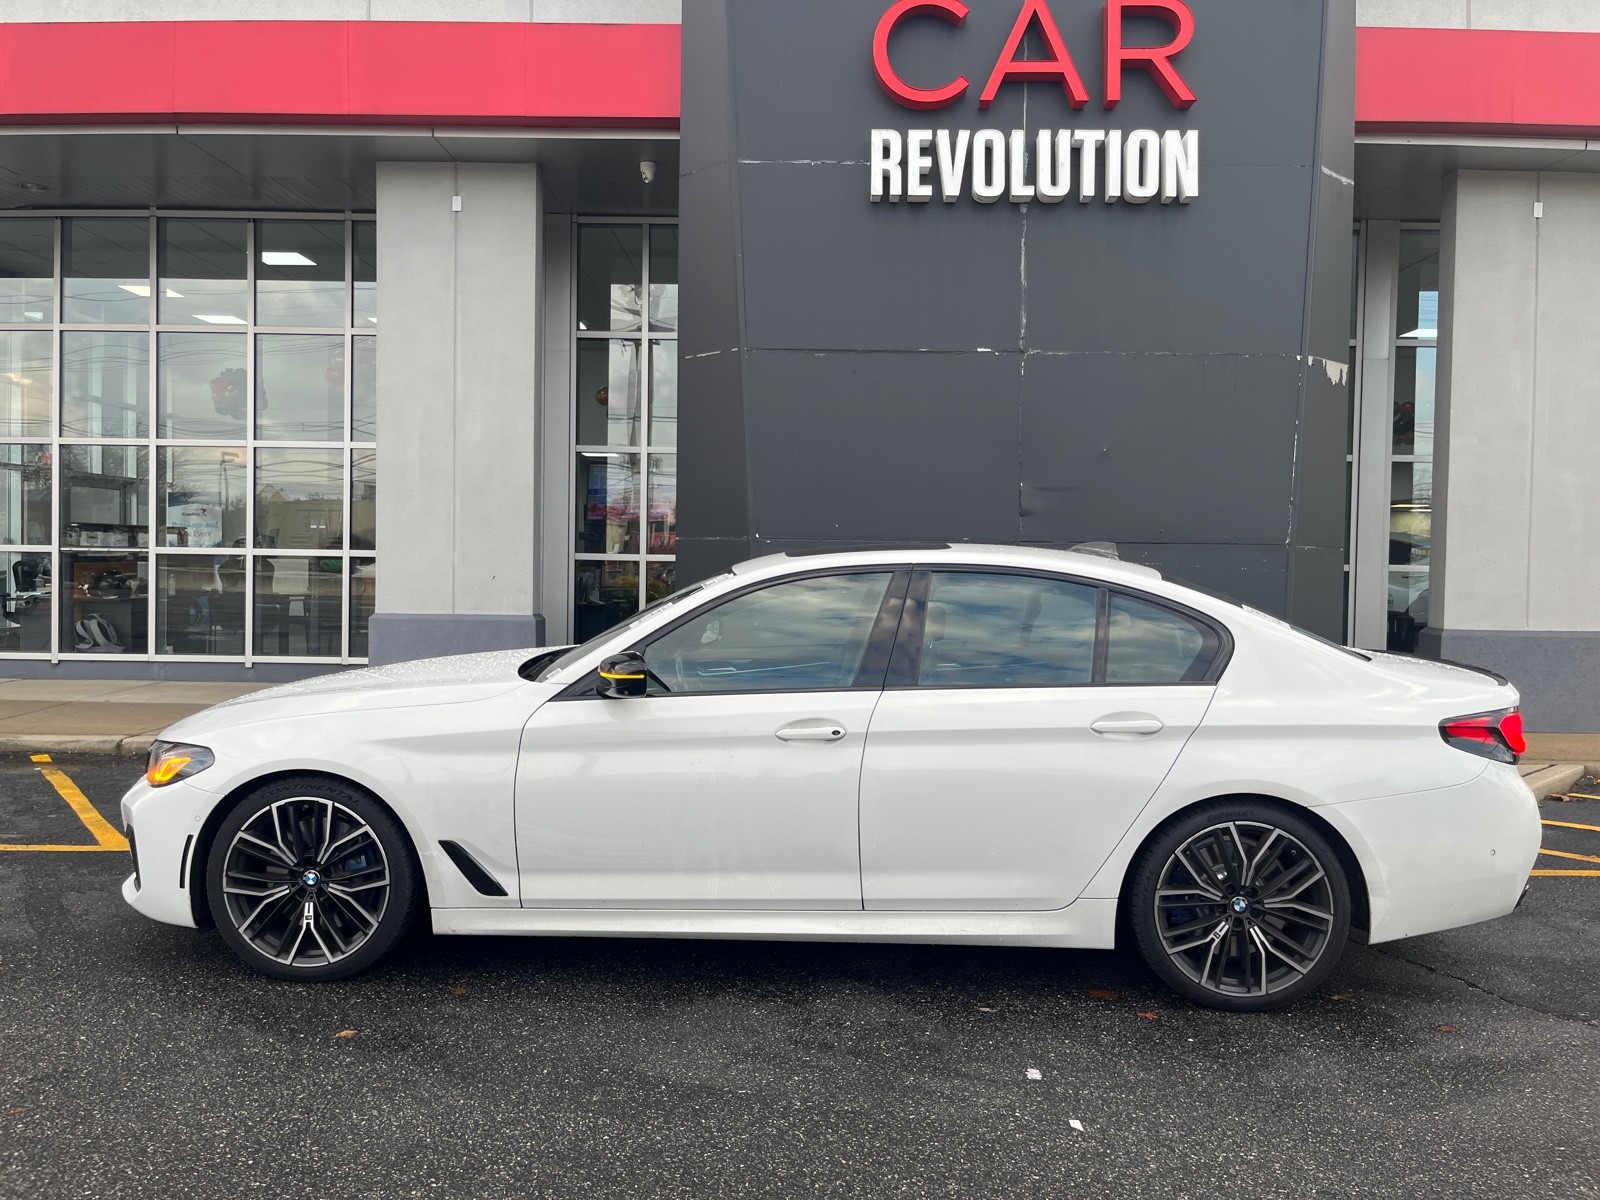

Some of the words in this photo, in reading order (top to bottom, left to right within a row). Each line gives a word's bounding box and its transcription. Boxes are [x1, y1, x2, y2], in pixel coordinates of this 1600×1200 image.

[872, 0, 1197, 110] CAR
[869, 128, 1199, 204] REVOLUTION
[261, 783, 360, 806] CONTINENTAL
[1207, 810, 1248, 823] Continental
